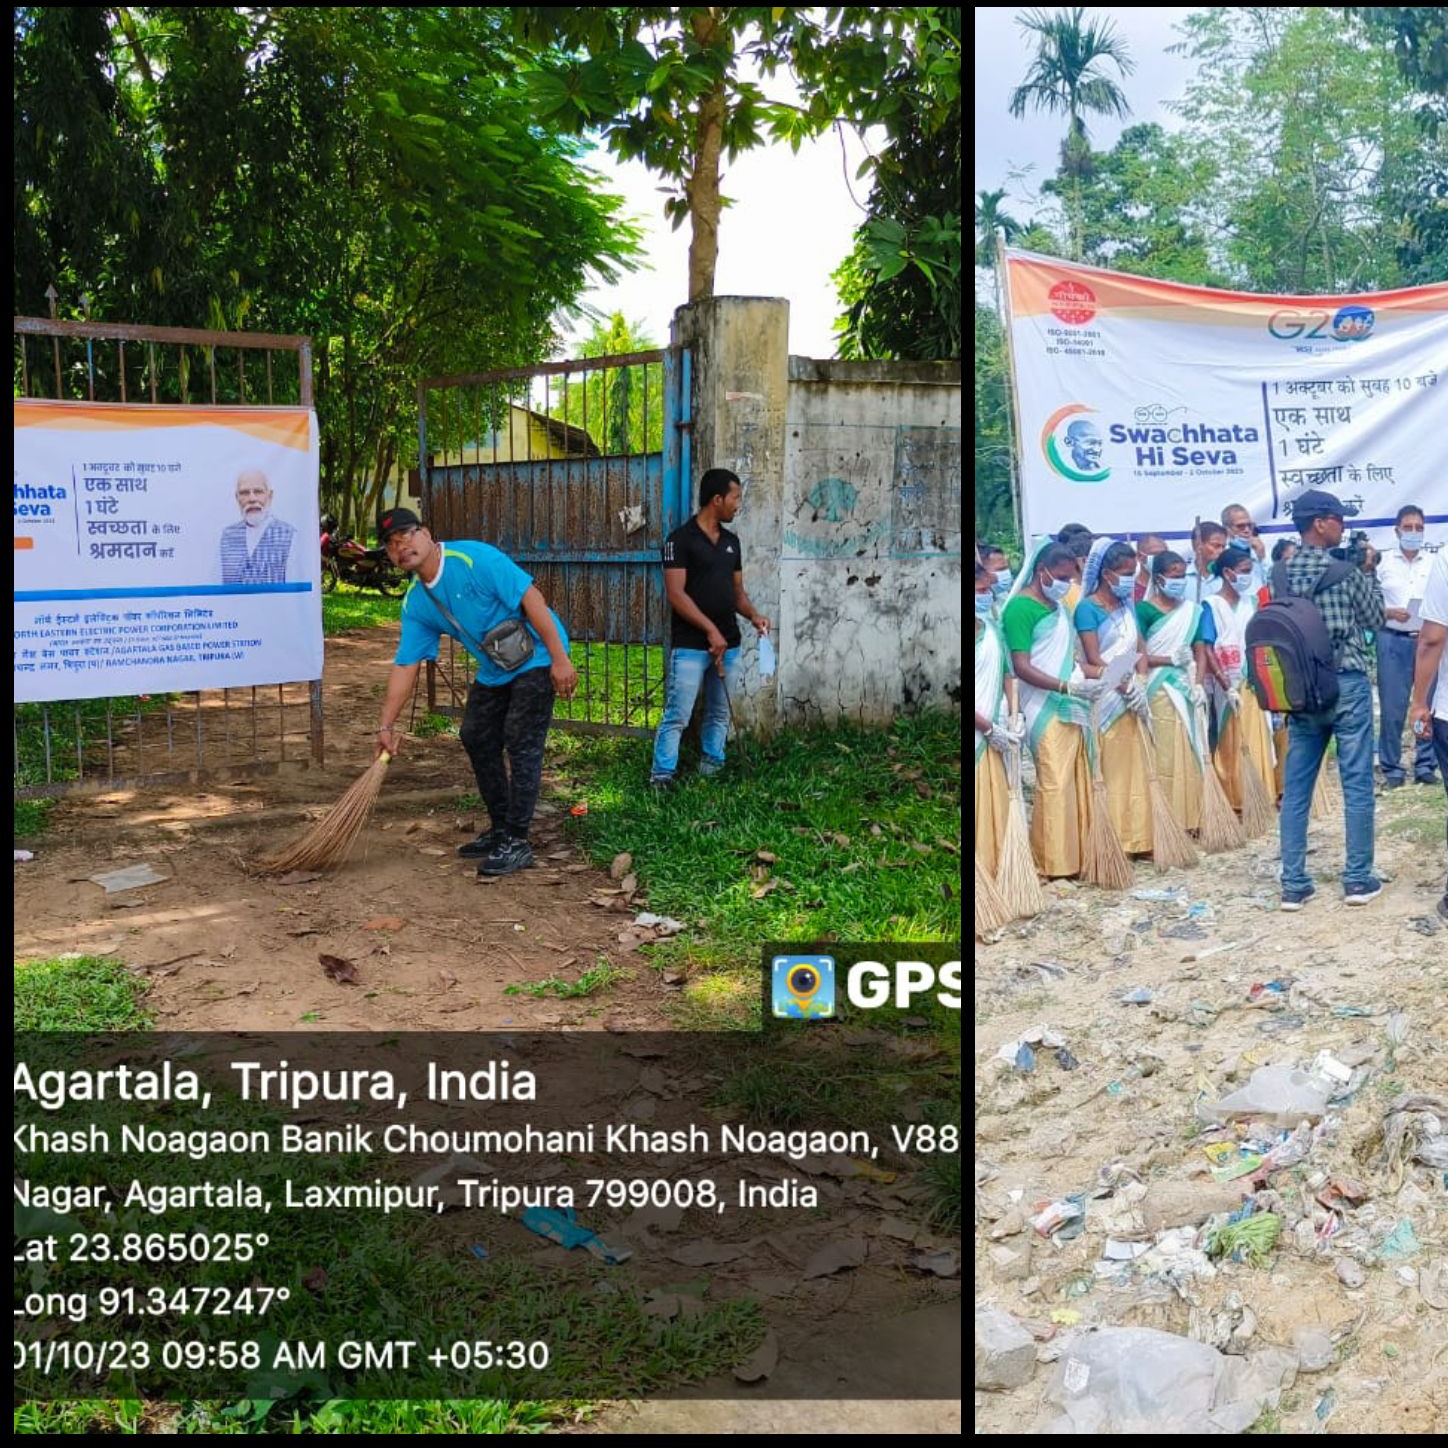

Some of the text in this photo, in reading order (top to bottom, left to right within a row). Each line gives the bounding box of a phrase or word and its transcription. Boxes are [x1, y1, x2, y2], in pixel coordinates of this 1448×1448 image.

[1272, 381, 1278, 395] 1
[1285, 380, 1333, 400] अक्टूबर
[1336, 375, 1356, 394] को
[1360, 379, 1390, 398] सुबह
[1395, 377, 1412, 390] 10
[1273, 406, 1352, 432] एक साथ
[1109, 423, 1259, 443] Swachhata
[1278, 430, 1325, 456] 1 घंटे
[1135, 446, 1237, 466] Hi Seva
[1279, 463, 1396, 487] स्वच्छता के लिए
[84, 478, 147, 492] एक साथ
[86, 496, 119, 515] 1 घंटे
[87, 520, 147, 535] स्वच्छता
[89, 541, 158, 559] श्रमदान
[80, 627, 117, 636] ELECTRIC
[119, 625, 149, 634] POWER
[207, 621, 239, 630] LIMITED
[202, 640, 231, 650] POWER
